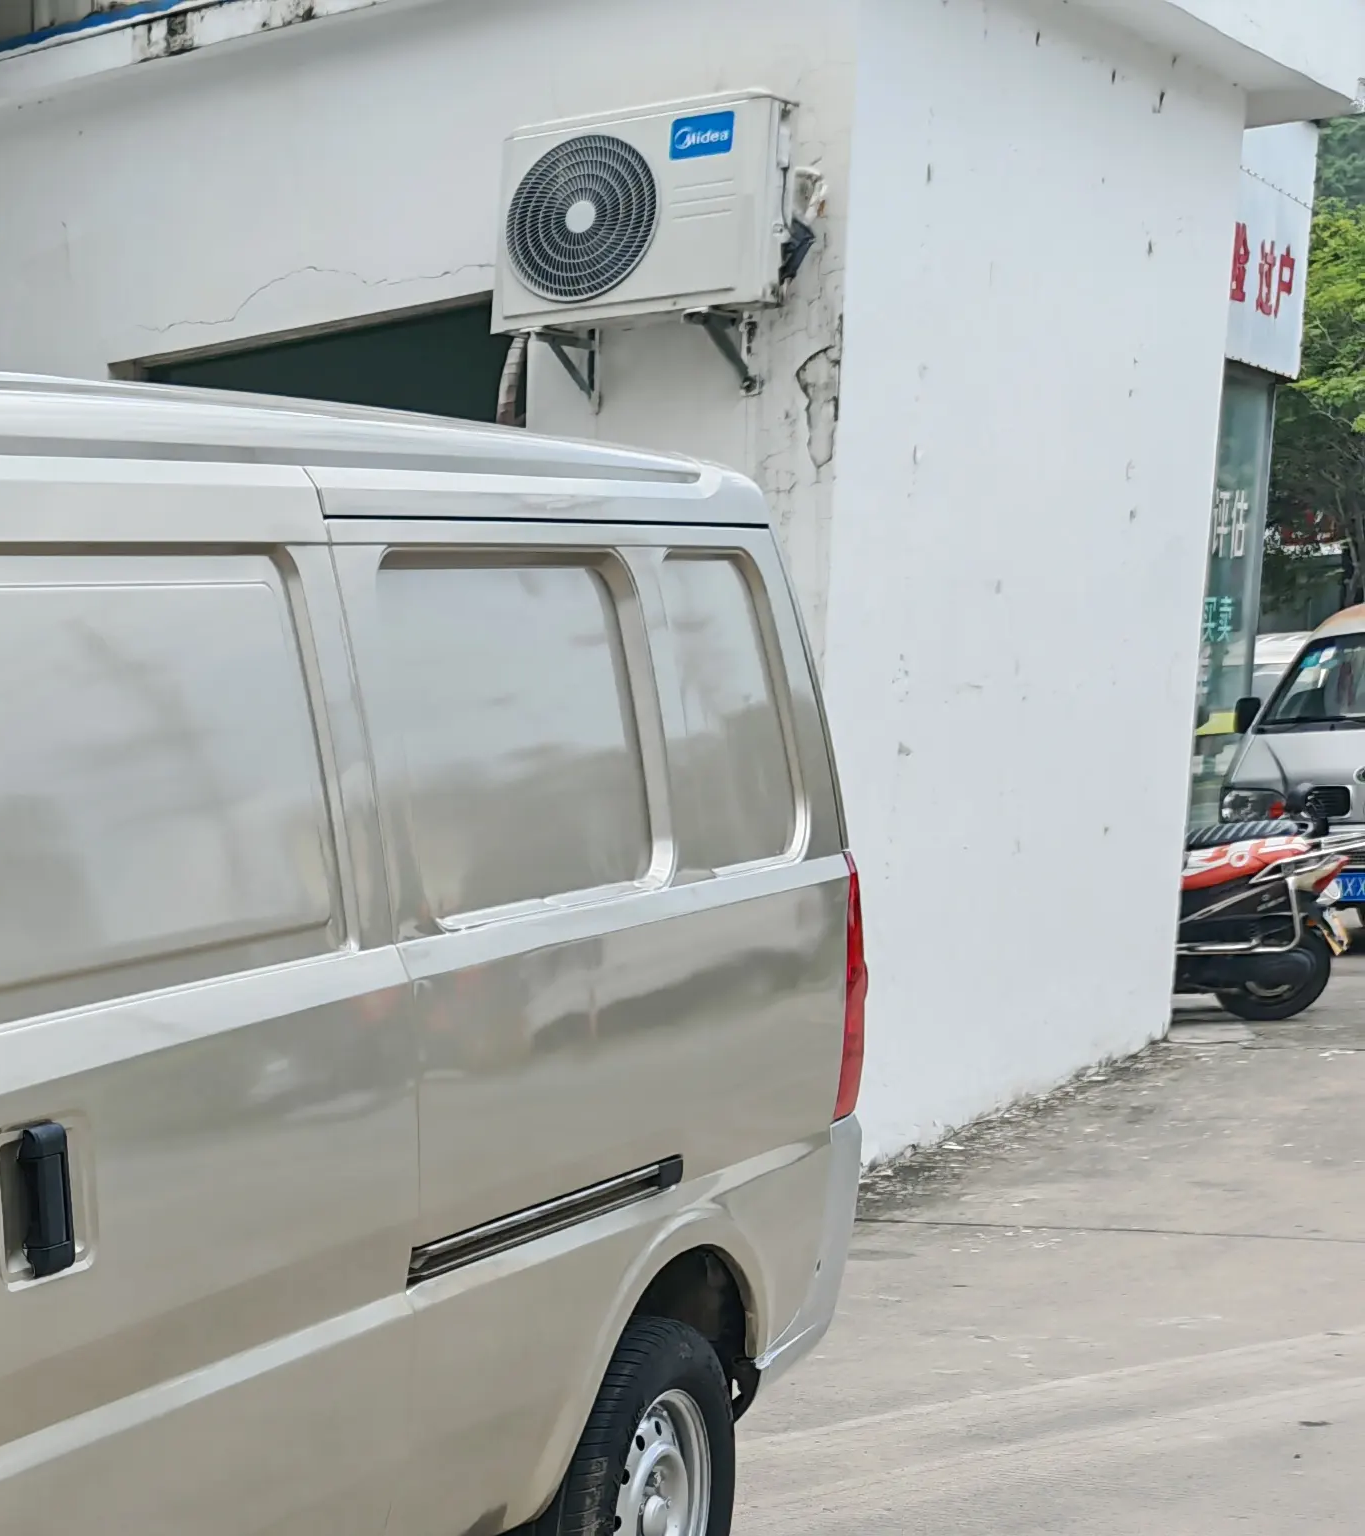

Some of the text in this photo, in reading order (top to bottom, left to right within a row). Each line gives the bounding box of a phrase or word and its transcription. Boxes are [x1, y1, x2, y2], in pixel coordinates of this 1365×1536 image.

[674, 126, 730, 149] Midea
[1212, 488, 1248, 559] 评估
[1202, 596, 1233, 642] 买卖
